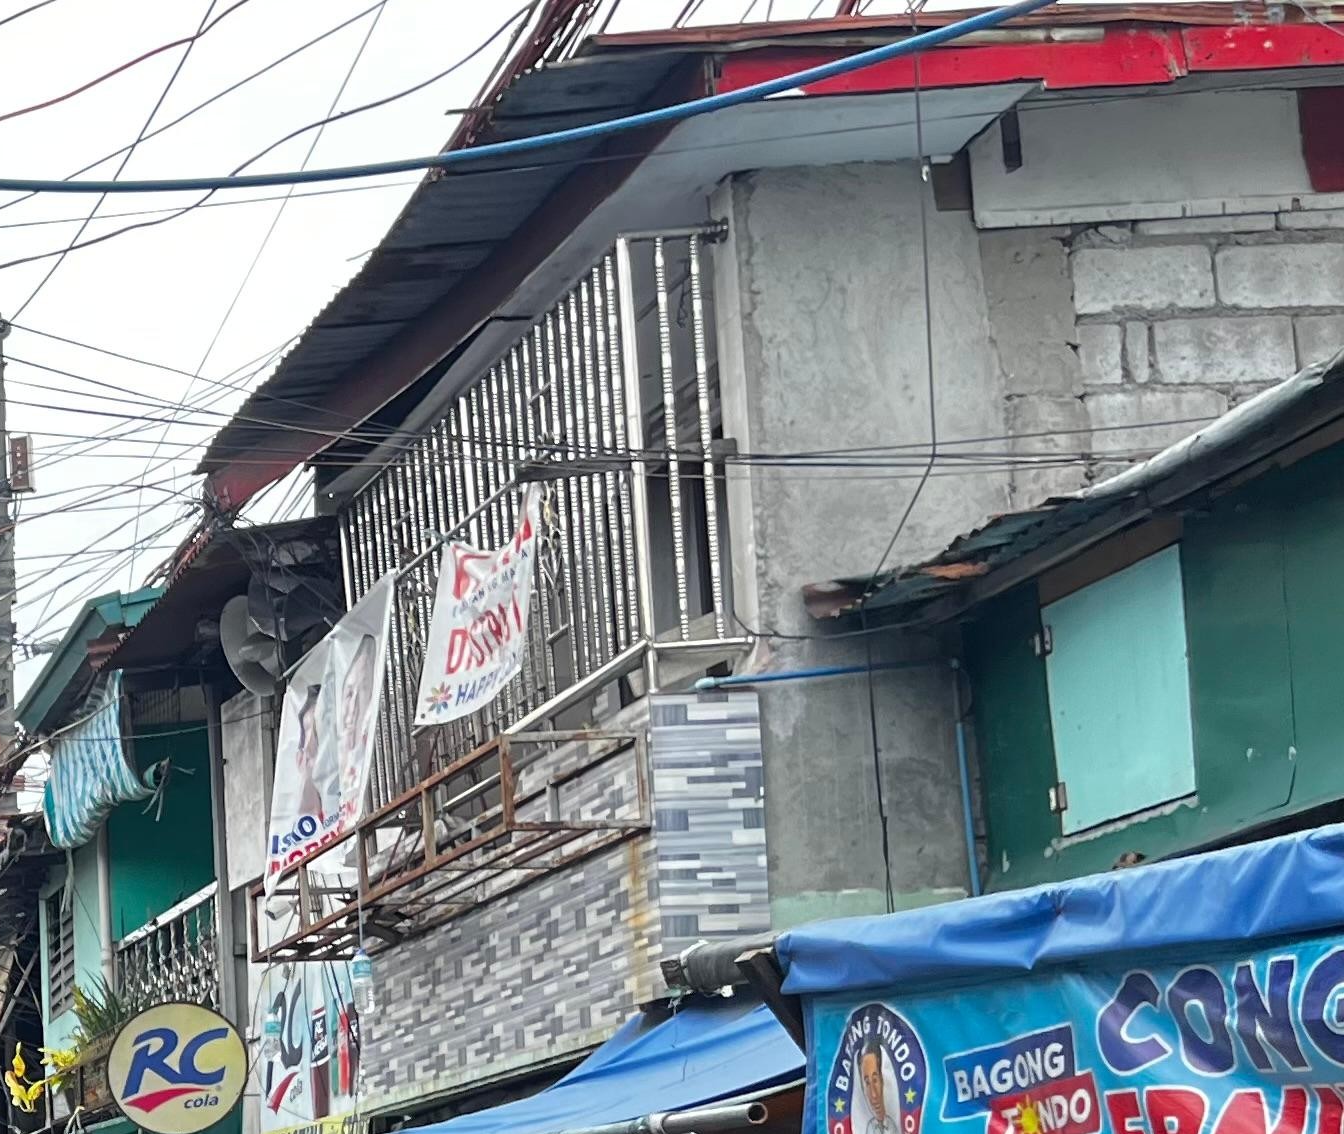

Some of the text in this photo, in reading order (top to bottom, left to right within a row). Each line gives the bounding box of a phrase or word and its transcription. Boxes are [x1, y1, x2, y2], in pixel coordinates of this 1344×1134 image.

[121, 1027, 230, 1099] RC
[876, 1015, 916, 1082] TONDO
[953, 1042, 1065, 1103] BAGONG
[183, 1093, 220, 1111] cola
